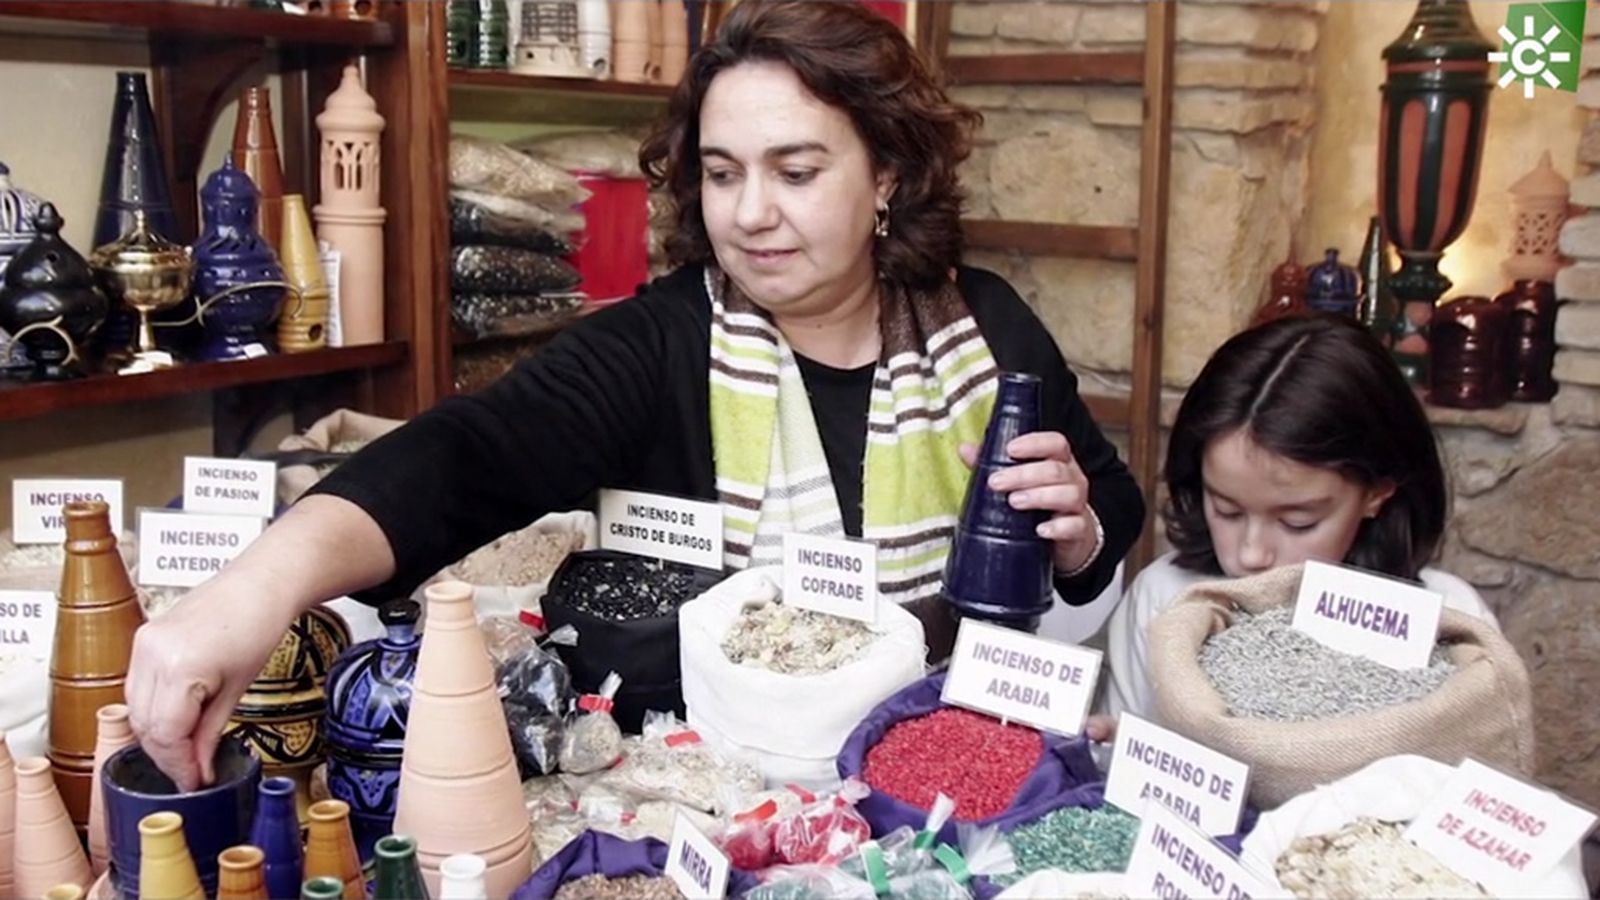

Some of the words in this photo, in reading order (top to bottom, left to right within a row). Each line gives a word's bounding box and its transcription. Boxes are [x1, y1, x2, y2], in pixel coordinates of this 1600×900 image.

[198, 467, 258, 482] INCIENSO
[30, 493, 104, 506] INCIENSO
[194, 485, 211, 498] DE
[214, 487, 260, 501] PASION
[627, 504, 679, 523] INCIENSO
[681, 512, 695, 526] DE
[160, 531, 239, 547] INCIENSO
[610, 522, 649, 540] CRISTO
[651, 529, 666, 543] DE
[668, 532, 713, 552] BURGOS
[798, 549, 862, 573] INCIENSO
[801, 576, 864, 601] COFRADE
[23, 603, 42, 618] DE
[1314, 590, 1409, 641] ALHUCEMA
[972, 642, 1055, 677] INCIENSO
[1058, 664, 1083, 685] DE
[986, 678, 1051, 710] ARABIA
[1126, 737, 1205, 788] INCIENSO
[1208, 774, 1234, 802] DE
[1464, 788, 1547, 837] INCIENSO
[1437, 812, 1465, 836] DE
[1460, 827, 1532, 872] AZAHAR
[679, 839, 712, 895] MIRRA
[1151, 823, 1225, 895] INCIENSO
